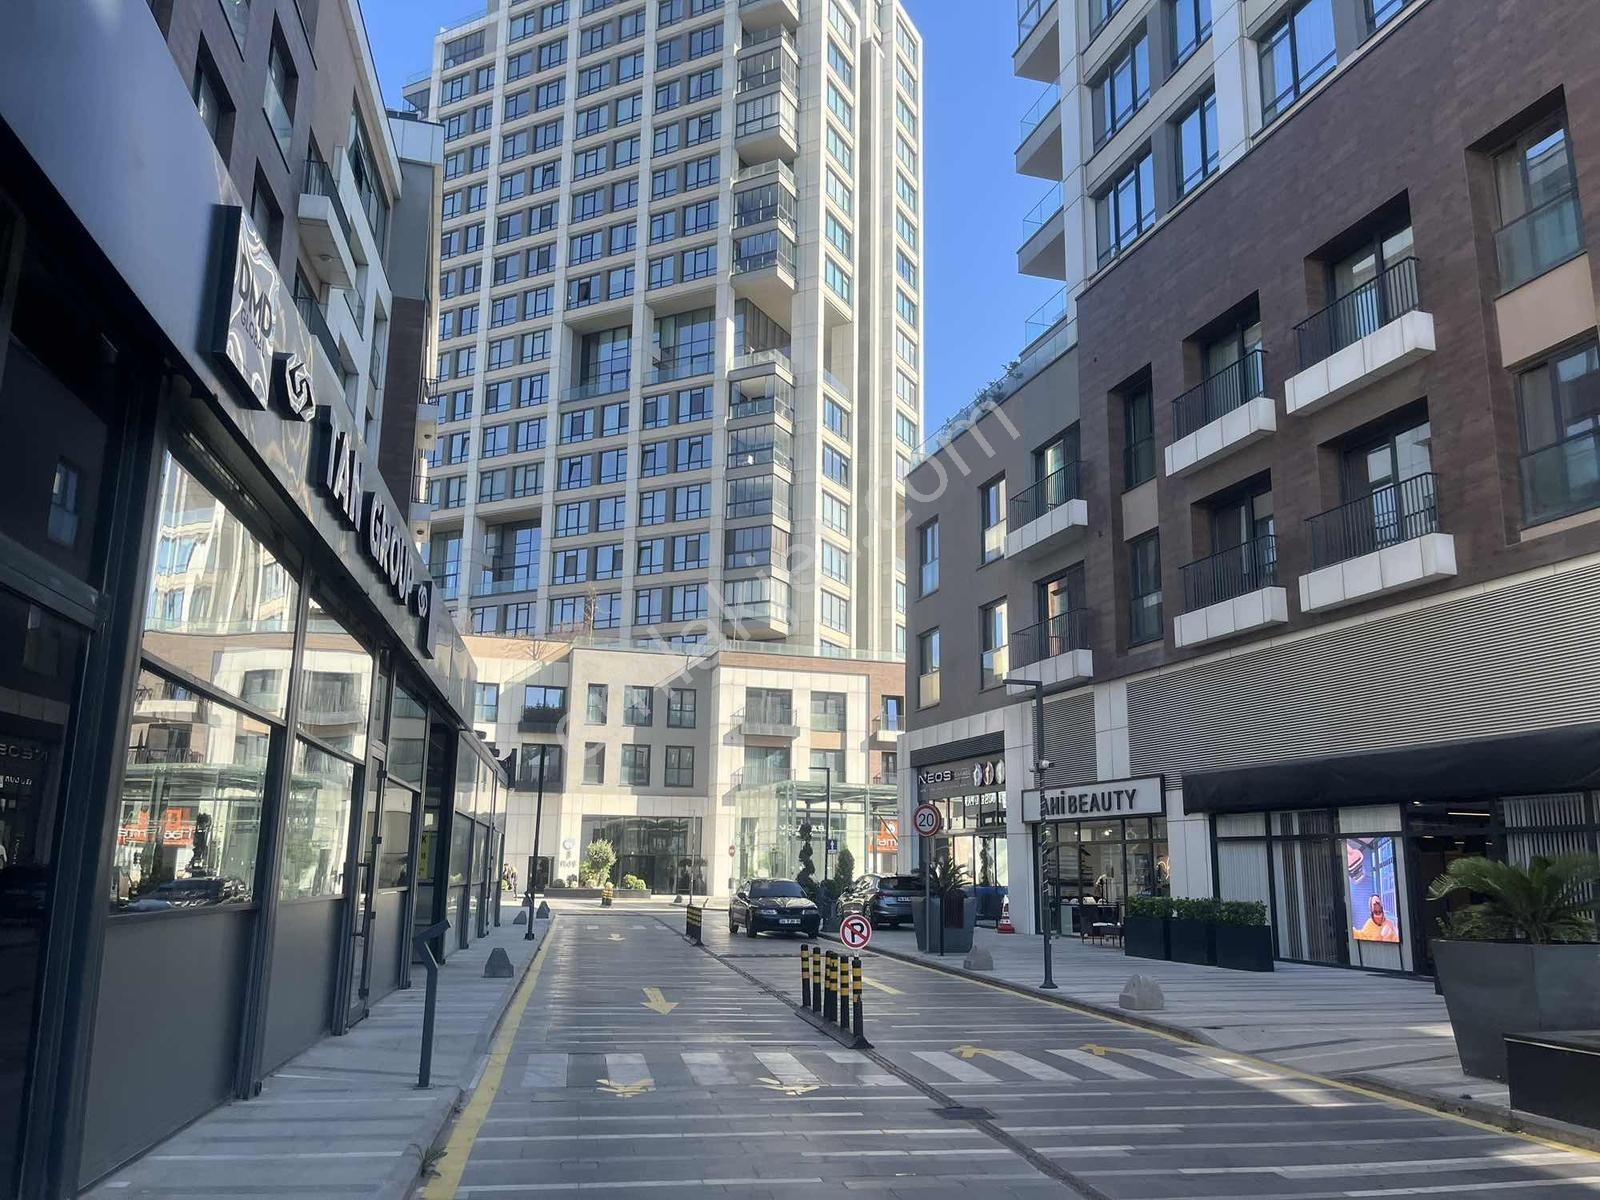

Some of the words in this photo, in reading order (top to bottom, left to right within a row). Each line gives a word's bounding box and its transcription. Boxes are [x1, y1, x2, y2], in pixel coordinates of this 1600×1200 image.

[238, 254, 272, 339] DMD
[240, 307, 265, 359] GLOBAL
[369, 494, 415, 606] GROUP
[918, 770, 951, 785] NEOS
[918, 813, 935, 827] 20
[1068, 788, 1138, 815] BEAUTY
